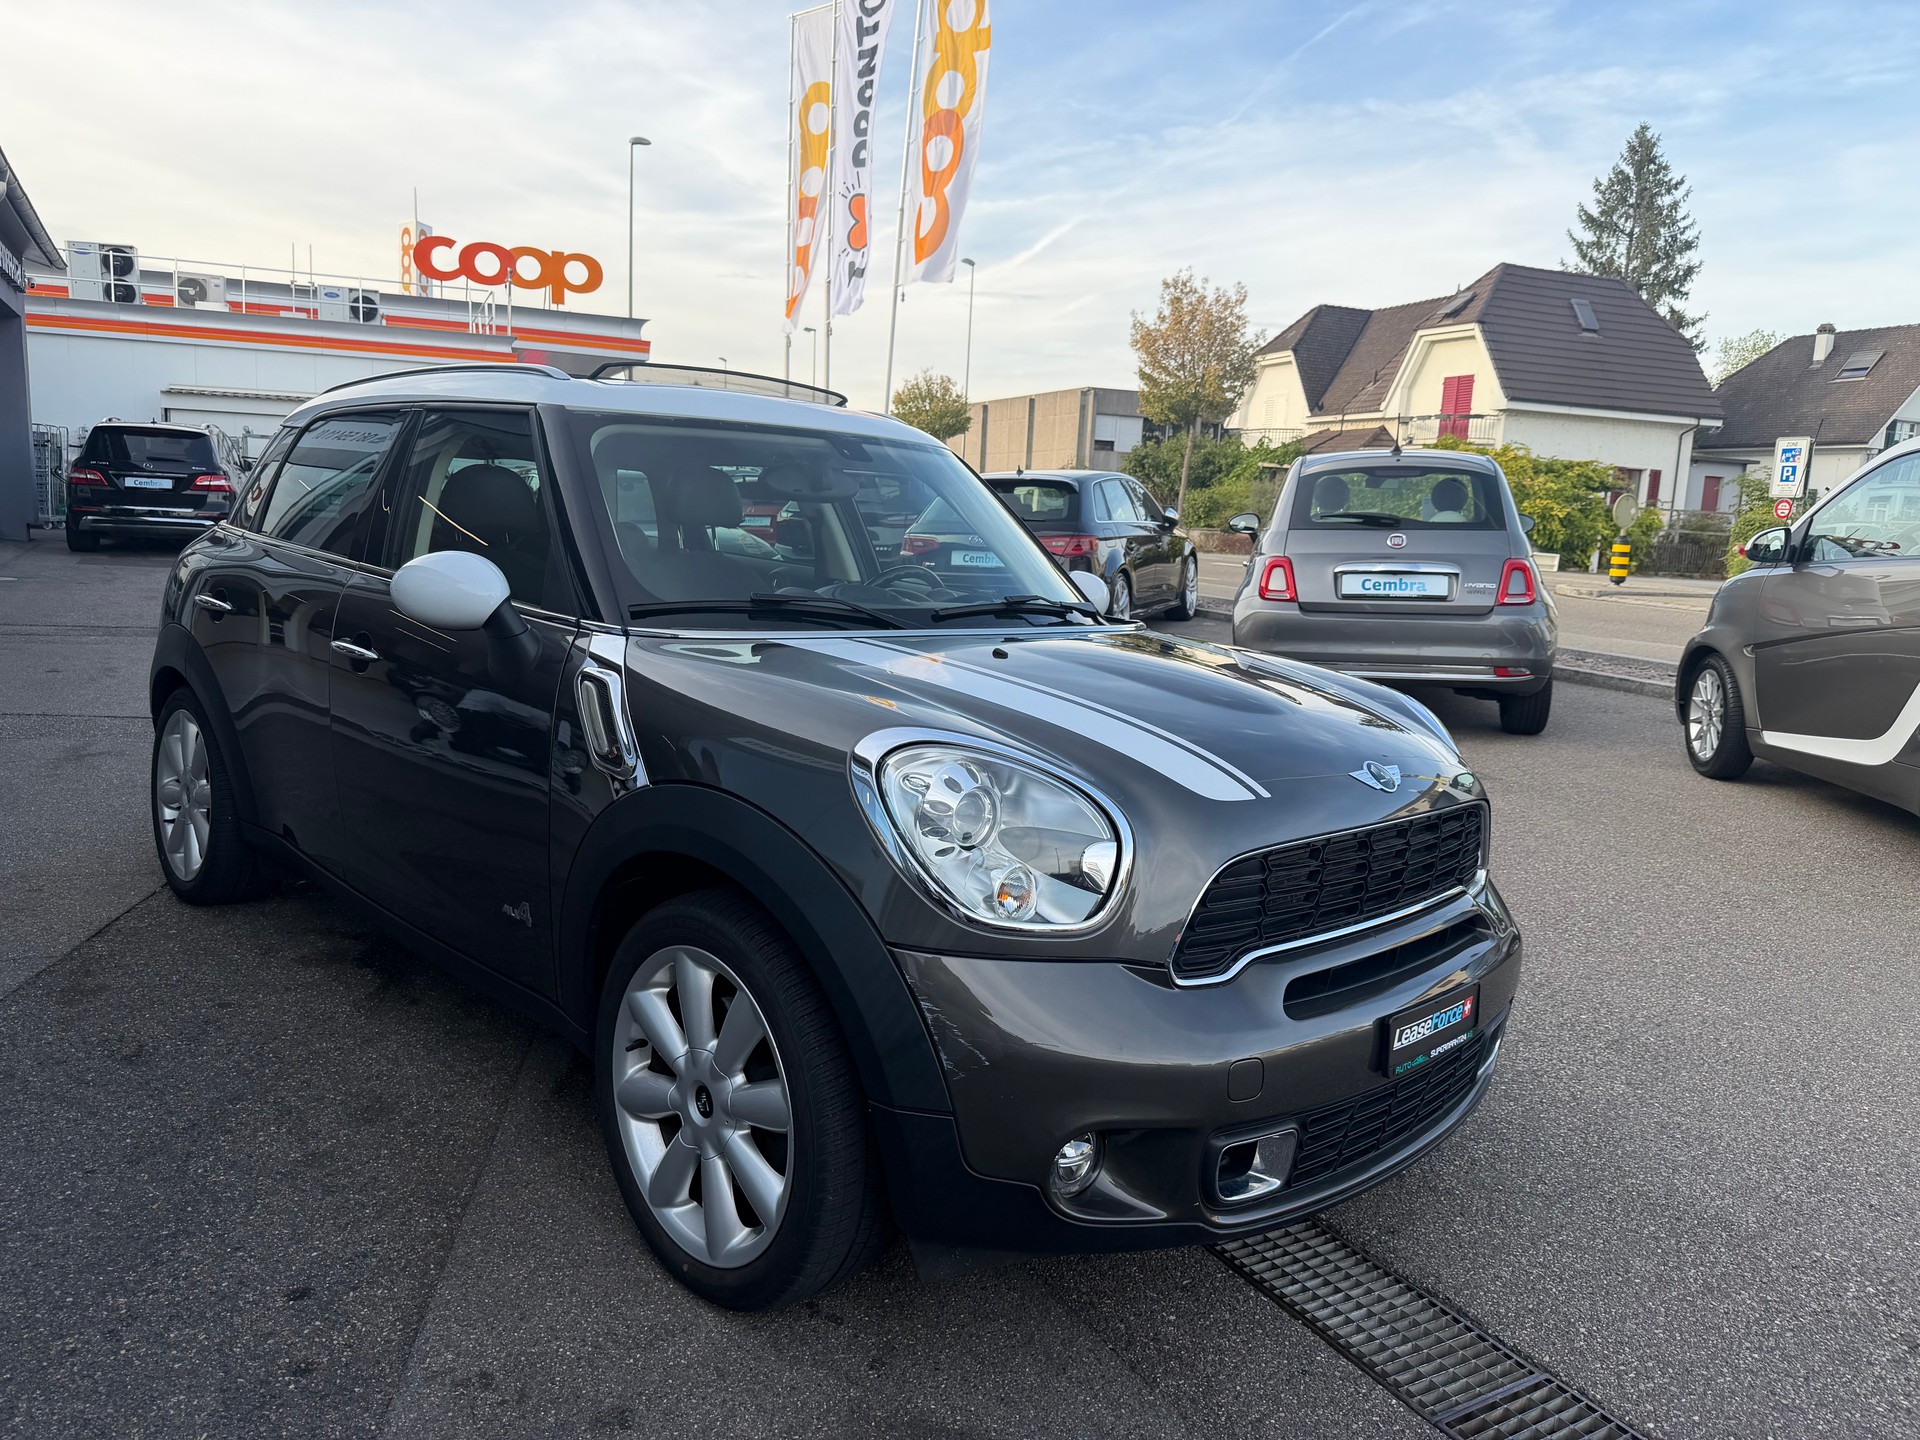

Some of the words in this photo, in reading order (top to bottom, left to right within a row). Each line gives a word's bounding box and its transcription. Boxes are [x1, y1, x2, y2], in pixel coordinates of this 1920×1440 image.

[915, 0, 991, 265] coop
[401, 227, 414, 296] oop
[413, 235, 603, 305] coop
[133, 479, 164, 487] Cembra
[1782, 467, 1792, 480] P
[1361, 577, 1428, 592] Cembra
[1393, 1004, 1464, 1048] LeaseForce
[1396, 1061, 1412, 1074] AUTO
